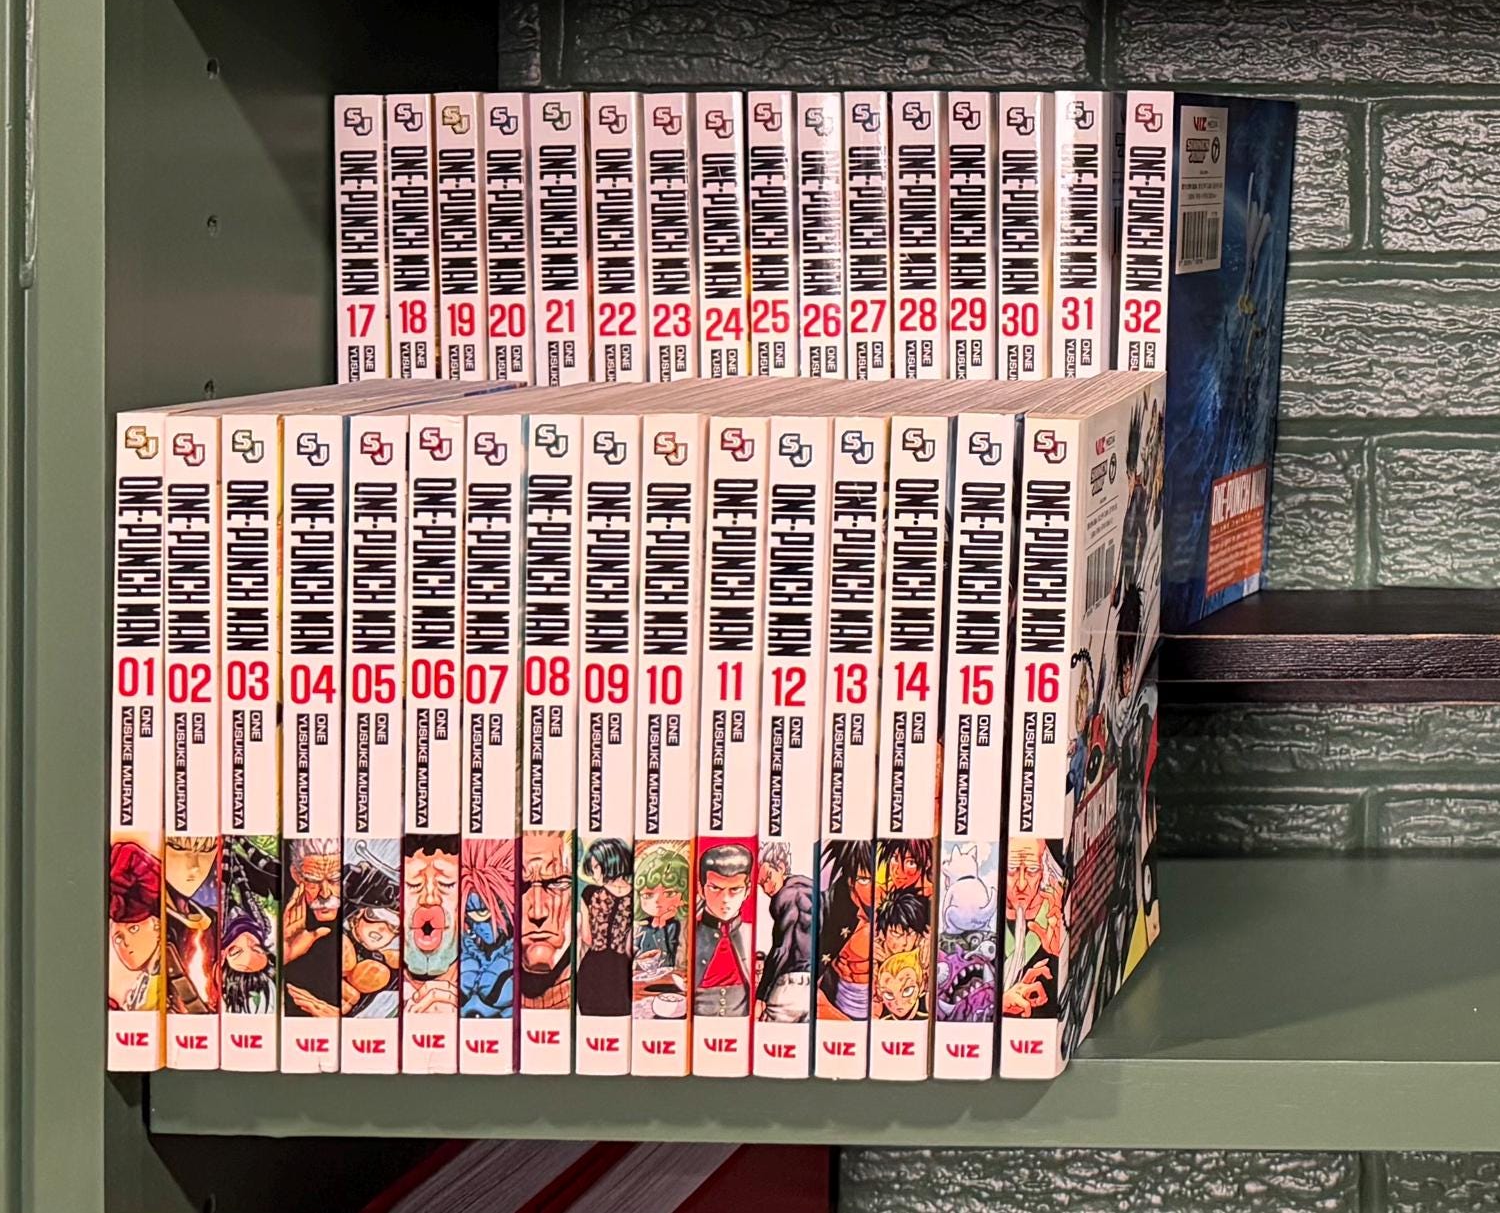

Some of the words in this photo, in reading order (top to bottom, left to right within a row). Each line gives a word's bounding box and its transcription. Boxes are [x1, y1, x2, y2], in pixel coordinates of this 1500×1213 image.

[340, 151, 378, 253] ONE-PUNCH
[487, 150, 525, 253] ONE-PUNCH
[596, 149, 634, 251] ONE-PUNCH
[751, 146, 788, 249] ONE-PUNCH
[899, 145, 936, 247] ONE-PUNCH
[1003, 150, 1039, 252] ONE-PUNCH
[342, 259, 378, 295] MAN
[489, 258, 525, 295] MAN
[598, 257, 634, 294] MAN
[752, 255, 788, 291] MAN
[900, 253, 936, 289] MAN
[1003, 258, 1038, 294] MAN
[348, 304, 375, 337] 17
[400, 300, 427, 334] 18
[448, 302, 475, 337] 19
[488, 303, 526, 338] 20
[546, 299, 574, 333] 21
[599, 302, 636, 336] 22
[653, 303, 692, 337] 23
[706, 308, 743, 341] 24
[751, 299, 790, 333] 25
[803, 304, 841, 337] 26
[851, 299, 886, 333] 27
[899, 297, 936, 331] 28
[948, 298, 987, 331] 29
[1002, 303, 1039, 337] 30
[1062, 297, 1093, 331] 31
[1124, 299, 1161, 333] 32
[227, 481, 268, 601] ONE-PUNCH
[413, 478, 456, 599] ONE-PUNCH
[586, 482, 630, 603] ONE-PUNCH
[711, 479, 757, 600] ONE-PUNCH
[770, 485, 815, 606] ONE-PUNCH
[957, 482, 1005, 604] ONE-PUNCH
[227, 608, 268, 650] MAN
[412, 606, 454, 649] MAN
[586, 610, 628, 653] MAN
[710, 607, 753, 650] MAN
[768, 613, 811, 656] MAN
[956, 611, 1001, 654] MAN
[118, 657, 154, 697] 01
[168, 663, 211, 703] 02
[227, 660, 269, 701] 03
[291, 664, 336, 705] 04
[352, 663, 396, 704] 05
[412, 659, 455, 699] 06
[466, 664, 508, 705] 07
[524, 656, 570, 696] 08
[585, 663, 629, 704] 09
[647, 665, 683, 705] 10
[719, 662, 742, 701] 11
[773, 667, 806, 707] 12
[834, 663, 868, 704] 13
[896, 662, 929, 701] 14
[961, 665, 993, 705] 15
[1025, 663, 1059, 703] 16
[233, 711, 245, 765] YUSUKE
[251, 711, 262, 741] ONE
[530, 706, 544, 761] YUSUKE
[550, 706, 563, 736] ONE
[667, 715, 680, 746] ONE
[977, 715, 991, 745] ONE
[647, 715, 661, 769] YUSUKE
[233, 769, 245, 827] MURATA
[530, 765, 544, 824] MURATA
[646, 773, 659, 833] MURATA
[231, 1035, 262, 1049] VIZ
[466, 1040, 498, 1054] VIZ
[704, 1038, 736, 1052] VIZ
[882, 1042, 914, 1056] VIZ
